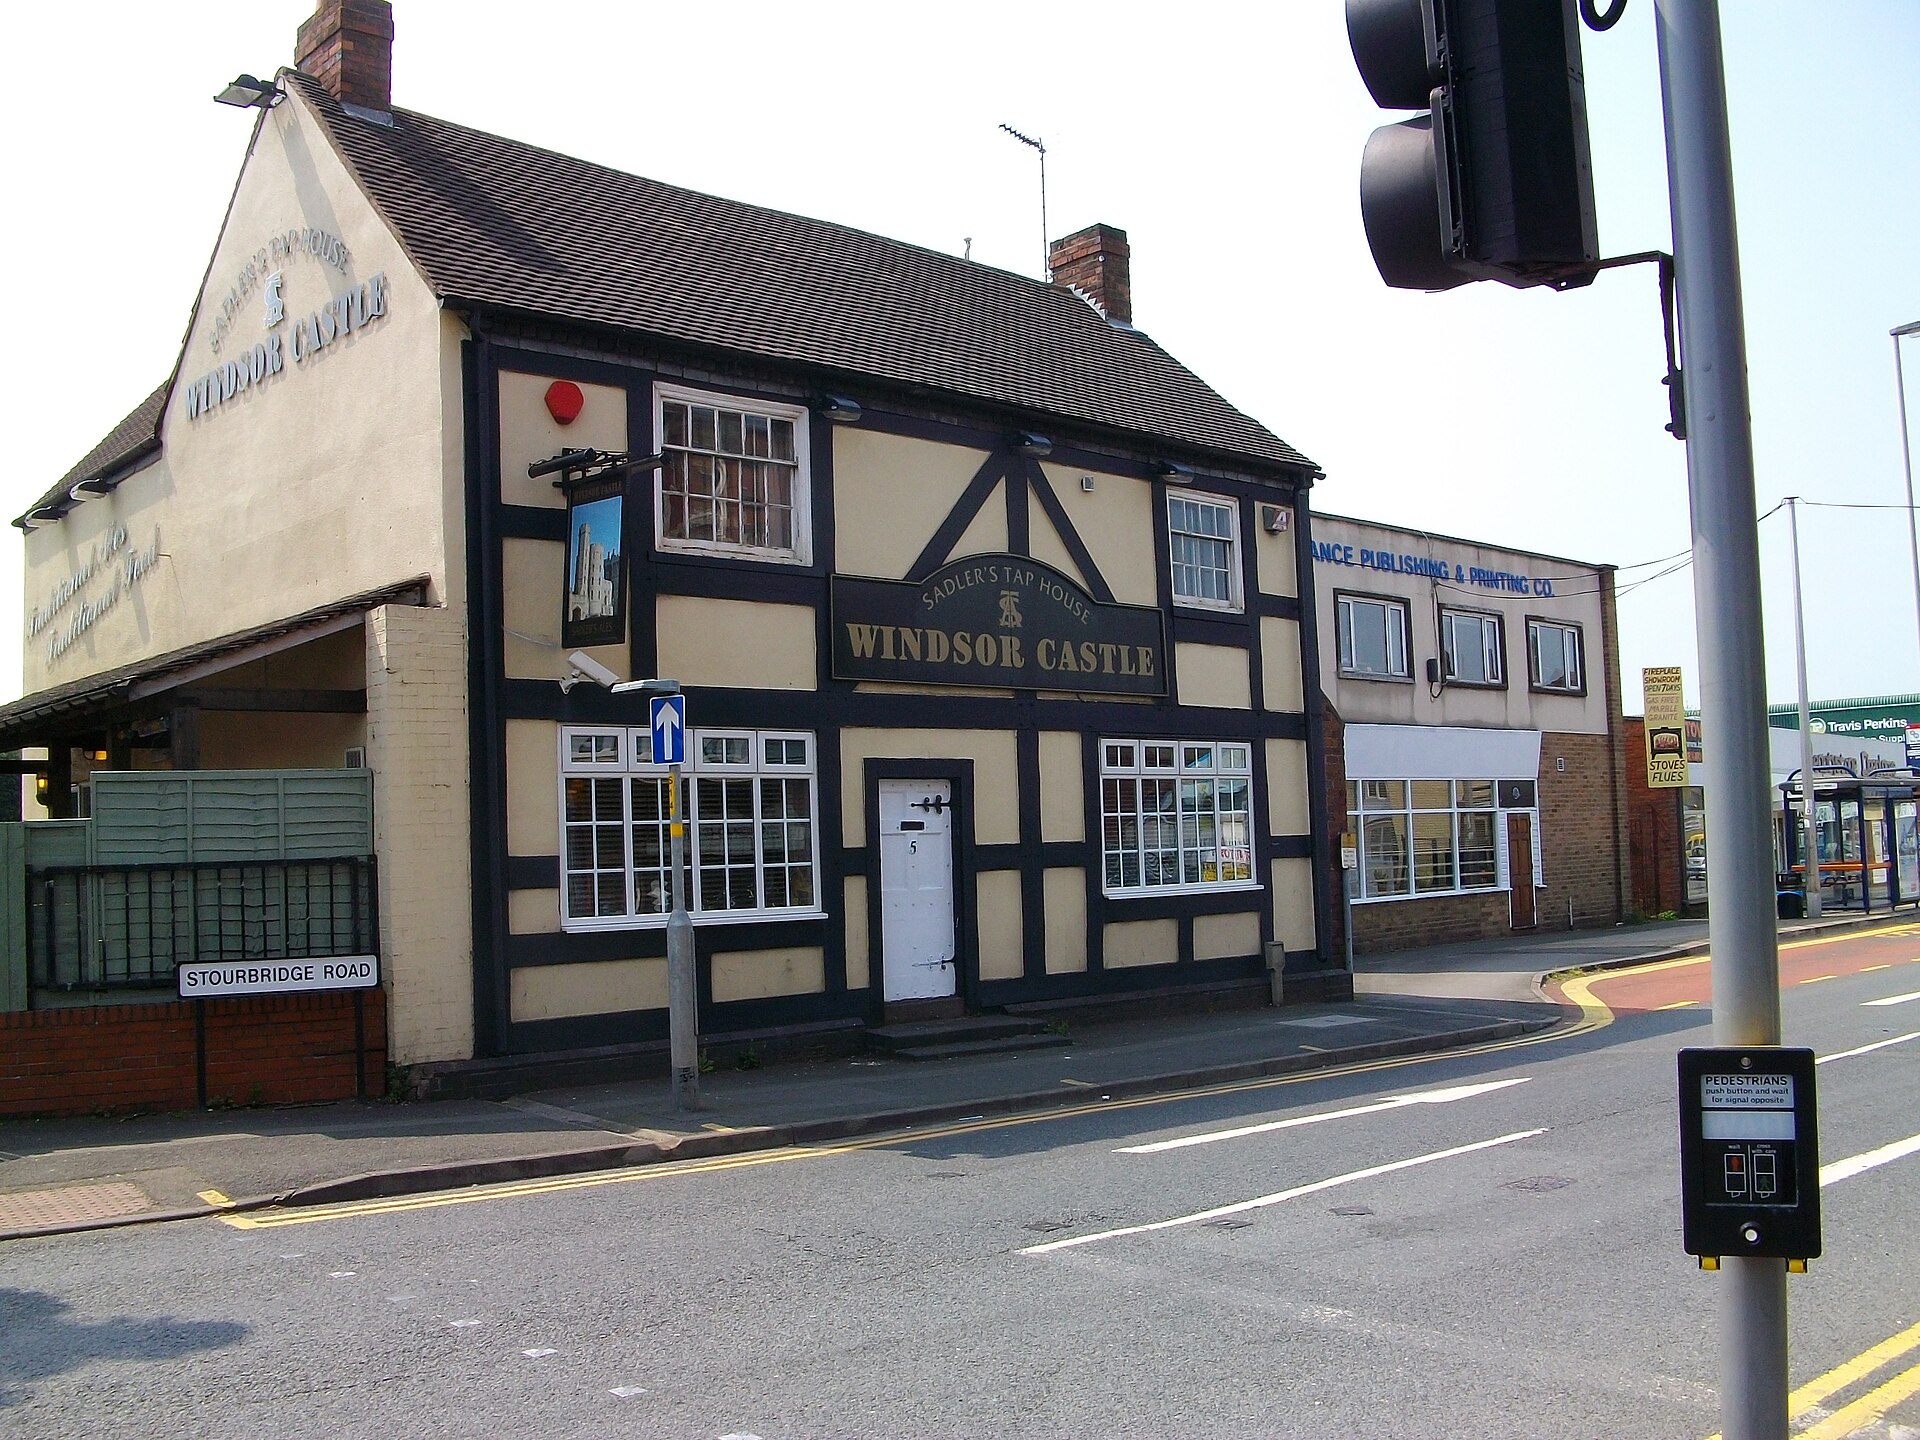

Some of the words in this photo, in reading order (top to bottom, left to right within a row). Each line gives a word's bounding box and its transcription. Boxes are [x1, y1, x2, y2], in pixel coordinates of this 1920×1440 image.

[269, 229, 298, 261] TAP
[301, 228, 351, 275] HOUSE
[185, 333, 282, 420] WINDSOR
[290, 271, 385, 362] CASTLE
[1361, 549, 1449, 580] PUBLISHING
[1455, 564, 1465, 583] &
[1470, 567, 1530, 594] PRINTING
[922, 565, 998, 611] SADLER'S
[1004, 566, 1034, 586] TAP
[1039, 579, 1091, 625] HOUSE
[846, 623, 1025, 668] WINDSOR
[1036, 638, 1155, 676] CASTLE
[1644, 667, 1680, 675] FIREPLACE
[1644, 676, 1680, 684] SHOWROOM
[1648, 704, 1679, 712] MARBLE
[1648, 713, 1678, 721] GRANITE
[1828, 720, 1862, 732] Travis
[1863, 718, 1907, 730] Perkins
[1650, 760, 1685, 771] STOVES
[1653, 772, 1684, 782] FLUES
[908, 841, 917, 855] 5
[186, 965, 314, 987] STOURBRIDGE
[323, 963, 371, 980] ROAD
[1705, 1076, 1787, 1086] PEDESTRIANS
[1725, 1096, 1748, 1104] signal
[1750, 1096, 1784, 1104] opposite
